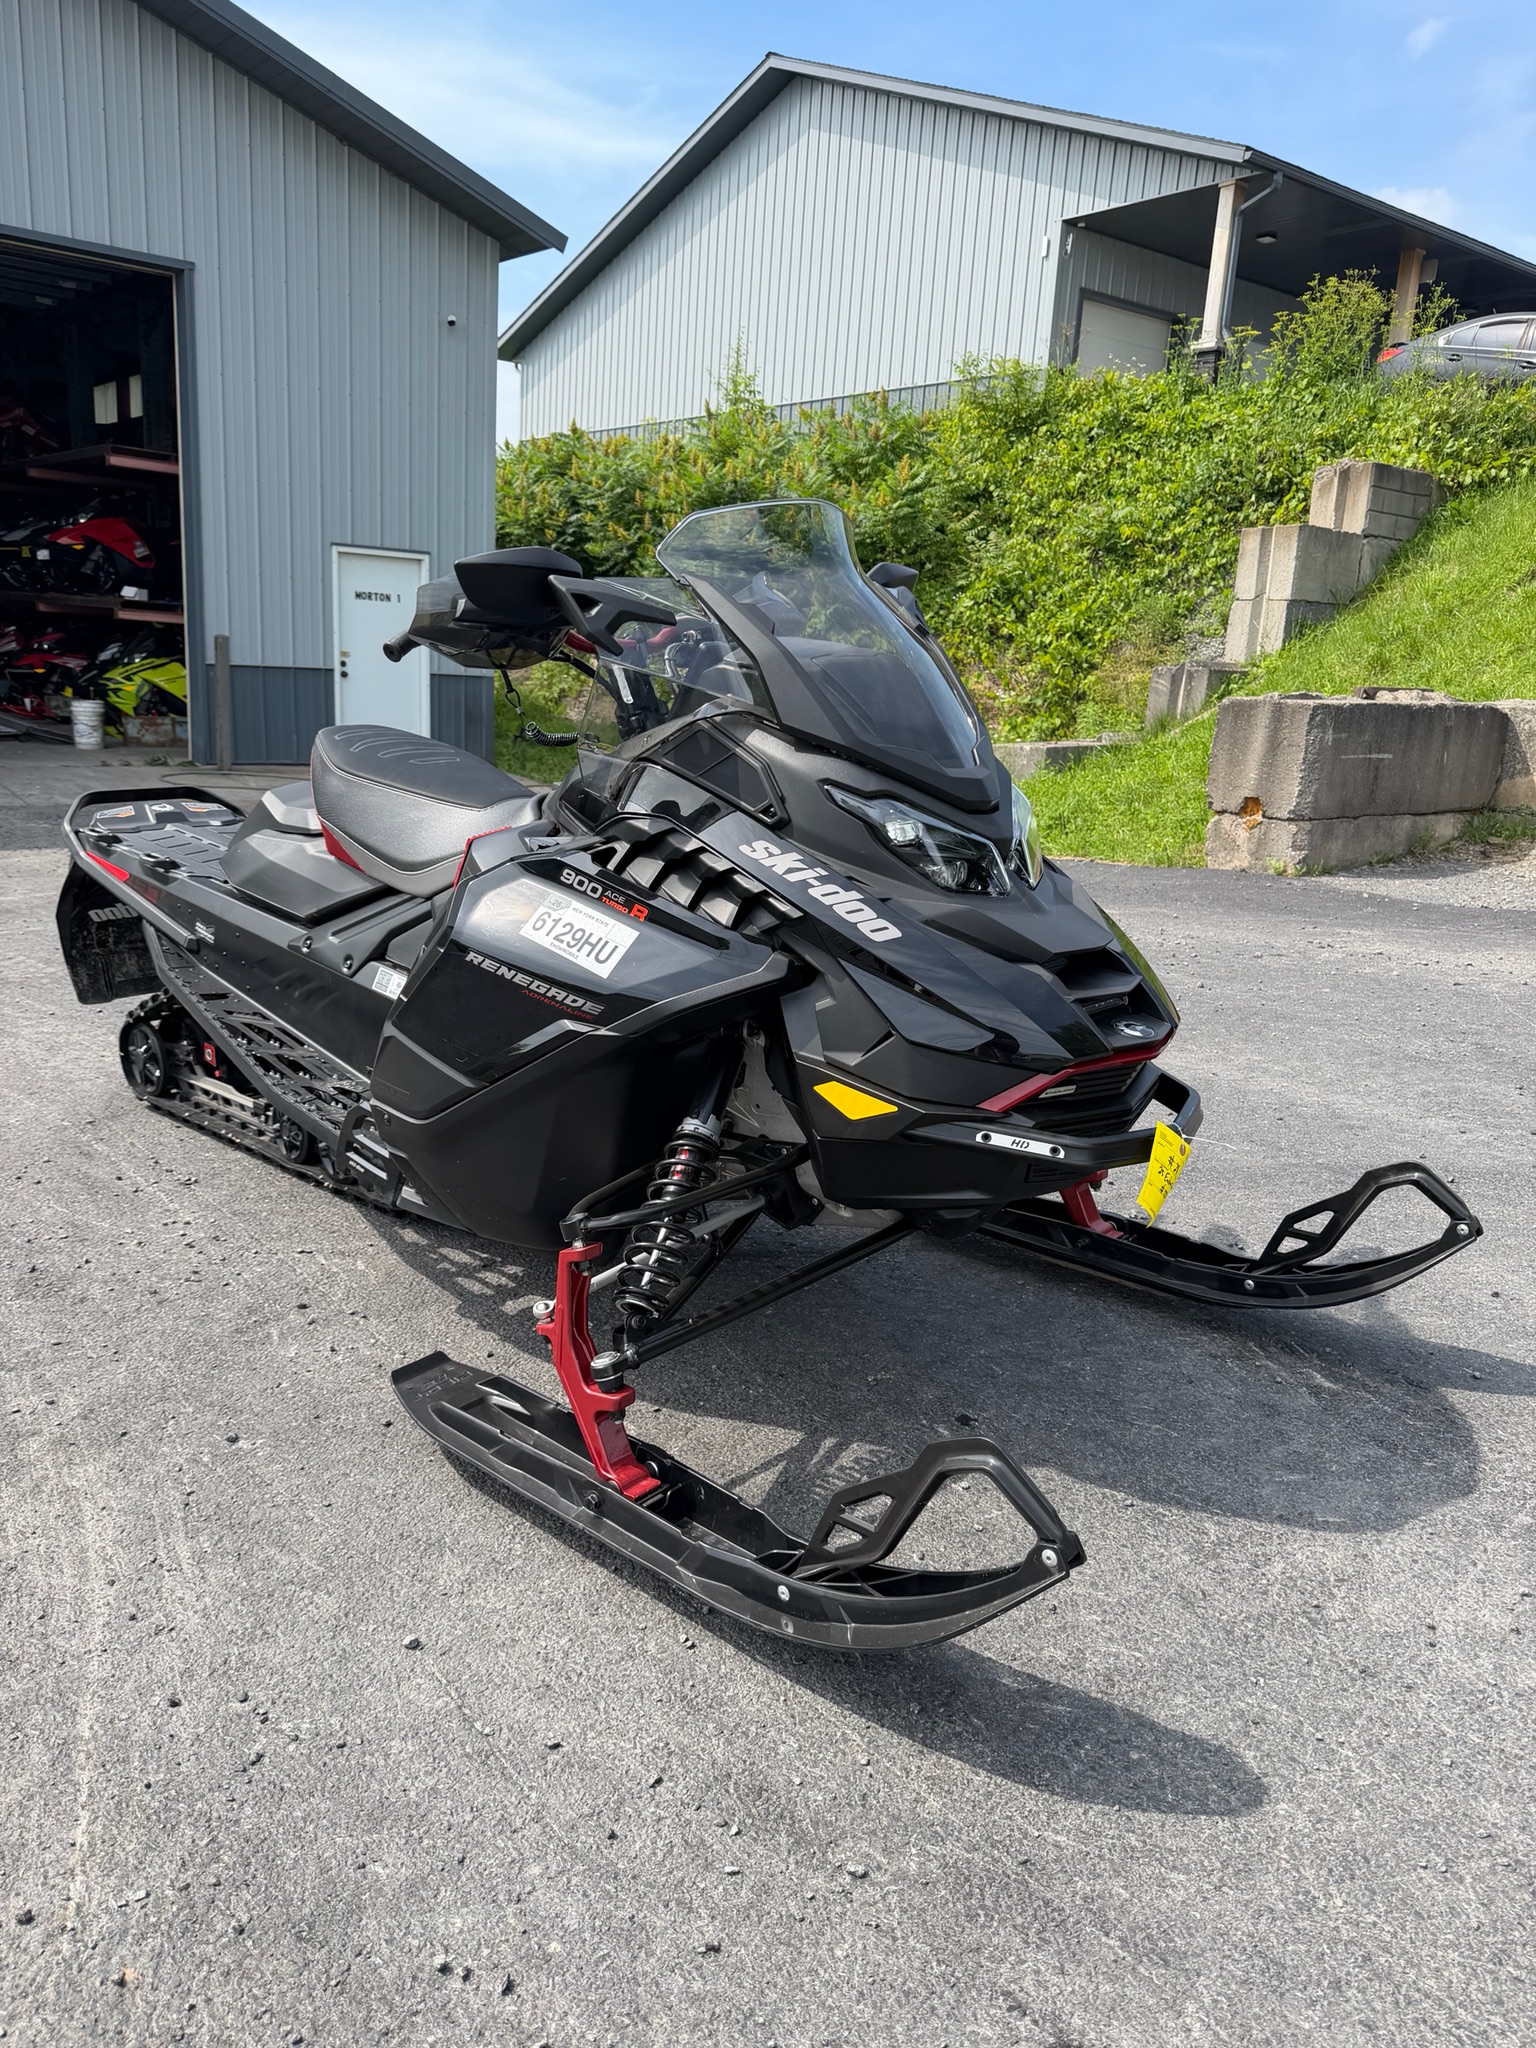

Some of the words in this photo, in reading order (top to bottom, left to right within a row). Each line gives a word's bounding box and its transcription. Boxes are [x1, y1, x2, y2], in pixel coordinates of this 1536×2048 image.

[354, 590, 391, 603] MORTON
[560, 868, 603, 899] 900
[604, 890, 626, 905] ACE
[739, 840, 903, 942] ski-doo
[571, 906, 584, 915] NEW
[583, 912, 596, 921] YORK
[594, 917, 610, 928] STATE
[601, 896, 629, 914] TURBO
[629, 903, 649, 922] R
[532, 911, 619, 964] 6129HU
[549, 942, 580, 960] SNOWMOBILE
[465, 951, 606, 1016] RENEGADE
[521, 989, 594, 1021] ADRENALINE
[1010, 1139, 1030, 1149] HD
